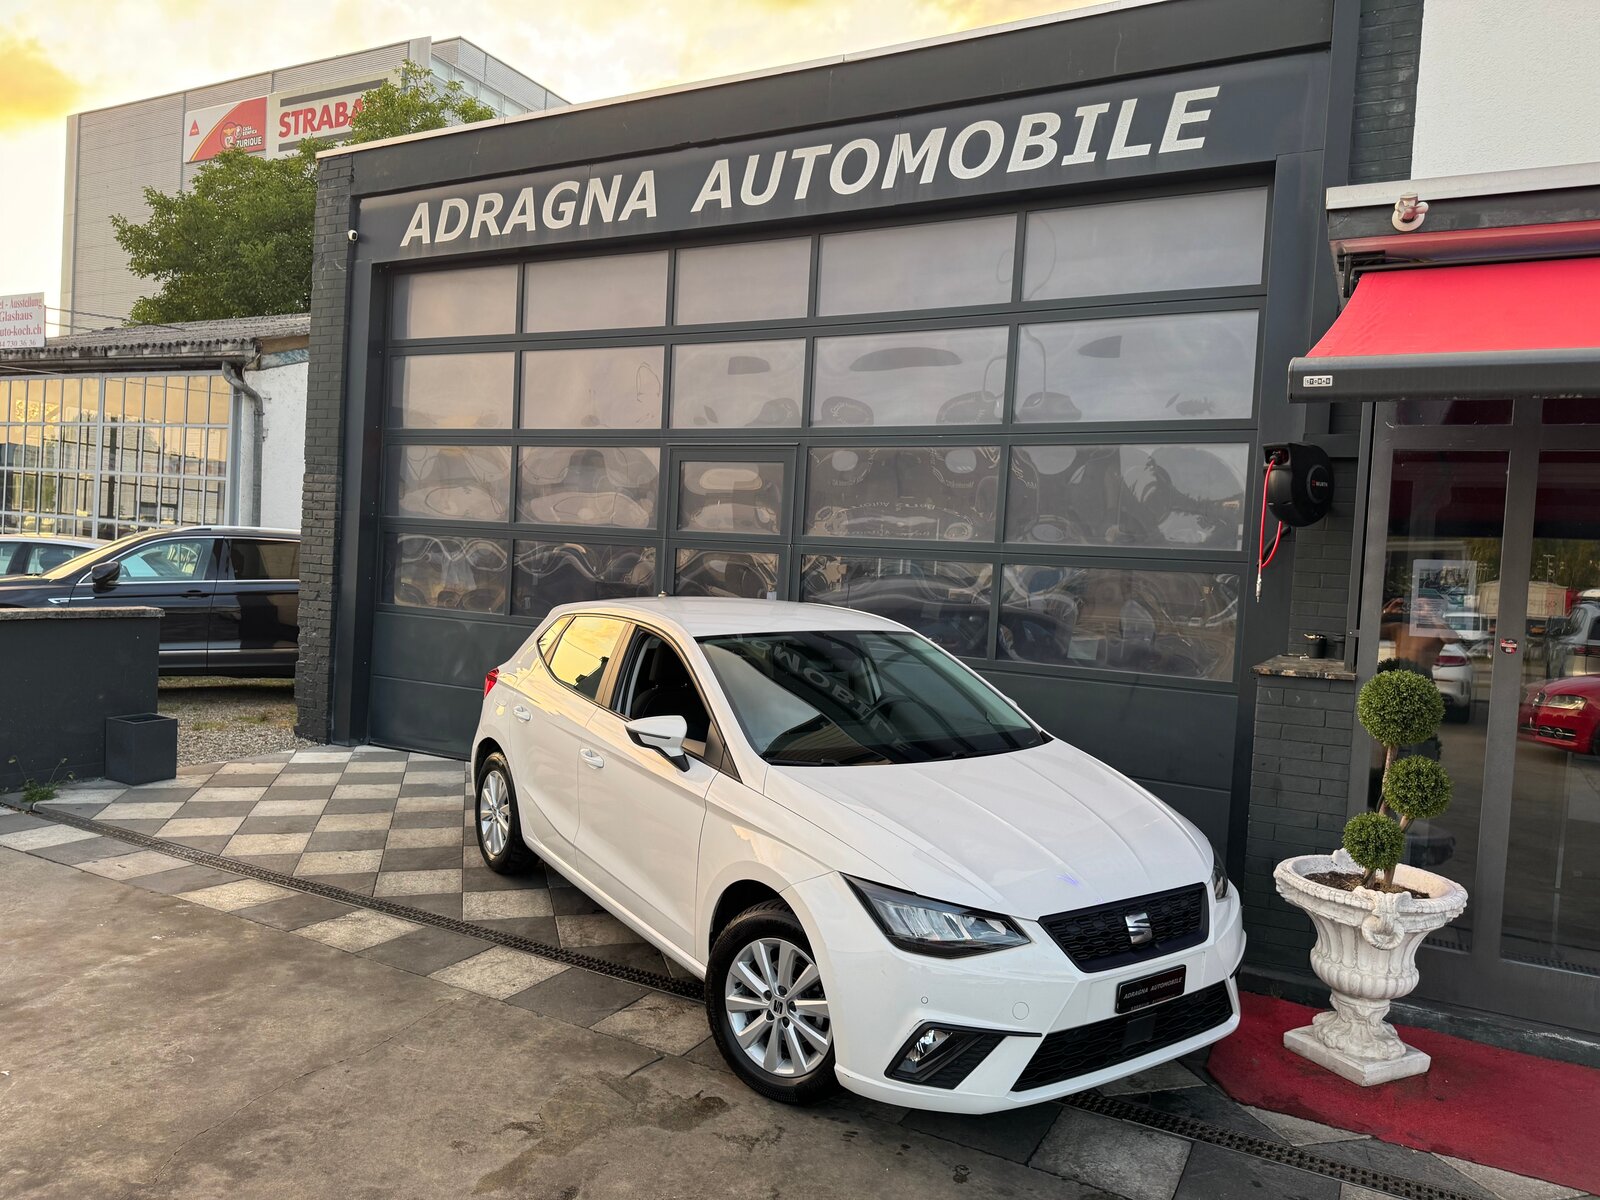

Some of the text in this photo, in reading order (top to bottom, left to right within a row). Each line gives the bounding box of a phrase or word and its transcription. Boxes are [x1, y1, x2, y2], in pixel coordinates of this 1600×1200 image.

[236, 136, 262, 147] ZURIQUE
[400, 86, 1221, 248] ADRAGNA AUTOMOBILE
[11, 296, 42, 309] Ausstellung
[1123, 976, 1183, 1000] ADRAGNA AUTOMOBILE
